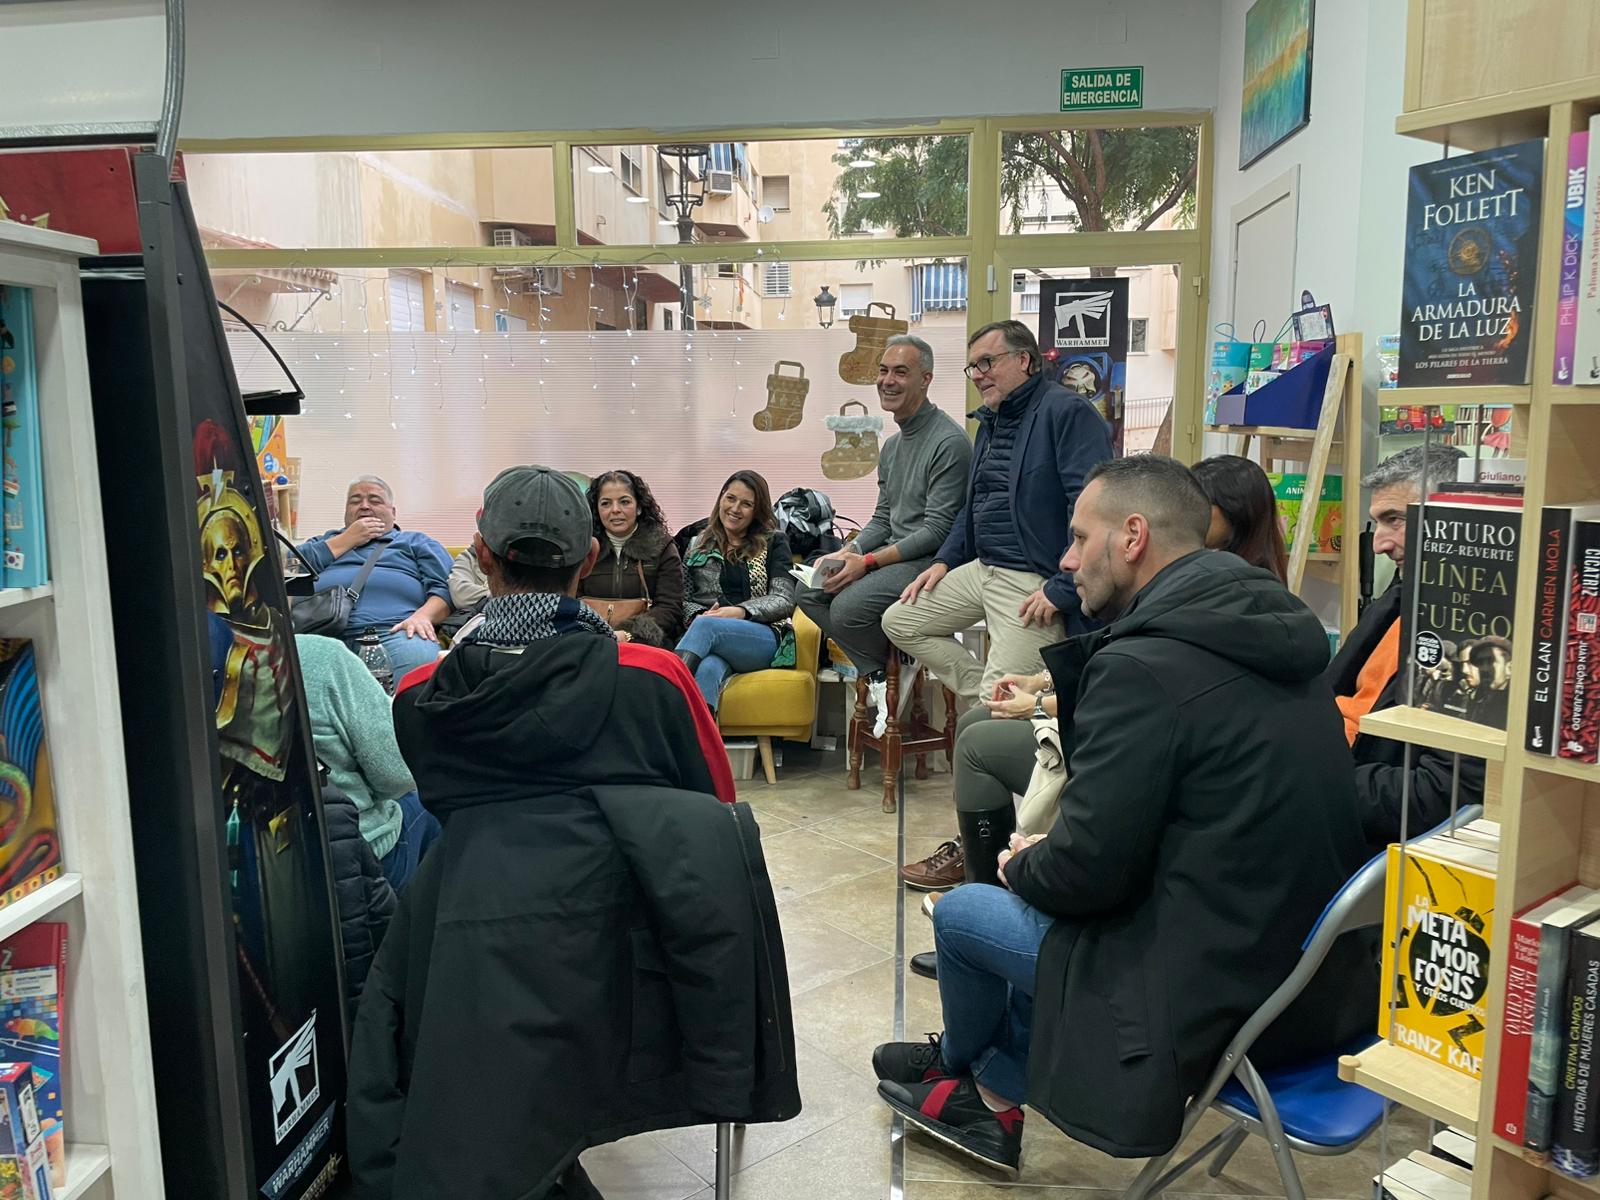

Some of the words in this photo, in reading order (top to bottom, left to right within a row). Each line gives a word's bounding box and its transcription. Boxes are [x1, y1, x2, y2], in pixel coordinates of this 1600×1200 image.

[1063, 89, 1139, 105] EMERGENCIA
[1071, 74, 1113, 89] SALIDA
[1116, 73, 1131, 87] DE
[1449, 169, 1497, 199] KEN
[1567, 166, 1586, 209] UBIK
[1423, 188, 1524, 231] FOLLETT
[1564, 233, 1579, 266] DICK
[1458, 281, 1477, 298] LA
[1564, 268, 1577, 281] K
[1411, 295, 1522, 322] ARMADURA
[1560, 282, 1576, 326] PHILIP
[1055, 339, 1108, 347] WARHAMMER
[1419, 323, 1443, 341] DE
[1449, 321, 1470, 339] LA
[1476, 317, 1513, 337] LUZ
[1415, 361, 1429, 369] LOS
[1429, 360, 1458, 369] PILARES
[1459, 359, 1470, 367] DE
[1471, 358, 1480, 366] LA
[1479, 471, 1521, 482] Giuliano
[1423, 540, 1515, 562] ÉREZ-REVERTE
[1548, 528, 1561, 573] MOLA
[1421, 557, 1509, 596] LÍNEA
[1581, 548, 1600, 597] CICATRIZ
[1452, 592, 1472, 606] DE
[1540, 575, 1557, 639] CARMEN
[1536, 641, 1552, 684] CLAN
[1576, 640, 1588, 664] JUAN
[1535, 687, 1548, 703] EL
[1415, 894, 1430, 910] LA
[1407, 904, 1468, 948] META
[1, 949, 12, 970] 2
[1430, 939, 1481, 978] MOR
[1414, 957, 1475, 1001] FOSIS
[1508, 964, 1526, 990] DEL
[1585, 960, 1600, 1011] CASADAS
[1414, 981, 1422, 993] Y
[1423, 986, 1449, 1004] OTROS
[1450, 996, 1486, 1017] CUENTOS
[1505, 993, 1522, 1036] CHIVO
[1570, 995, 1584, 1041] CAMPOS
[1580, 1013, 1595, 1061] MUJERES
[1447, 1044, 1483, 1074] KAF
[1565, 1043, 1580, 1090] CRISTINA
[1579, 1062, 1590, 1078] DE
[1573, 1080, 1588, 1133] HISTORIAS
[272, 1116, 330, 1194] WARHAMMER
